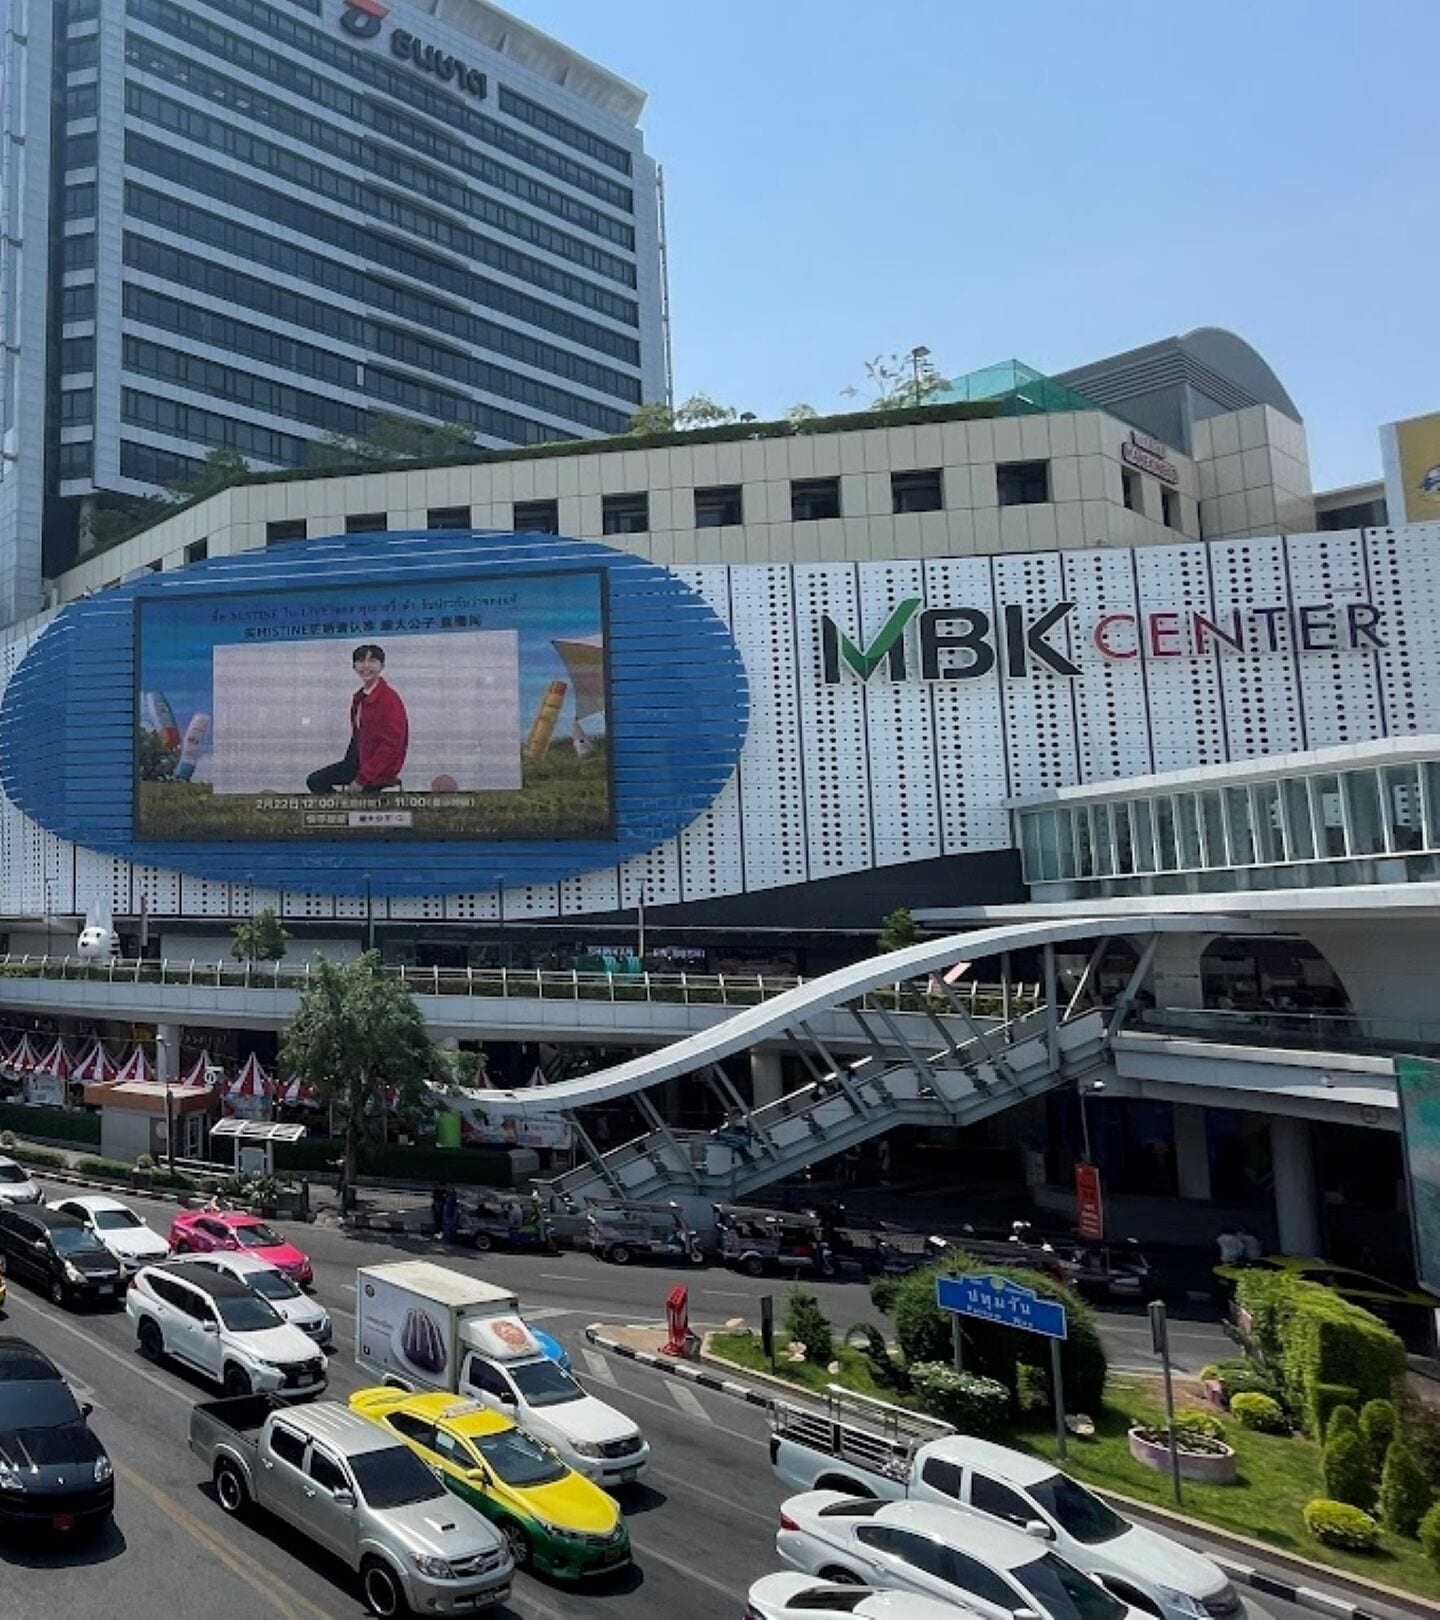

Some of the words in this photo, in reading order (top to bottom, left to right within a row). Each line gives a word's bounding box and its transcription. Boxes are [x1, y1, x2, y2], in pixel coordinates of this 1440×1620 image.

[822, 597, 1086, 685] MBK
[1094, 602, 1389, 660] CENTER
[967, 1288, 1032, 1316] ปทุมวัน
